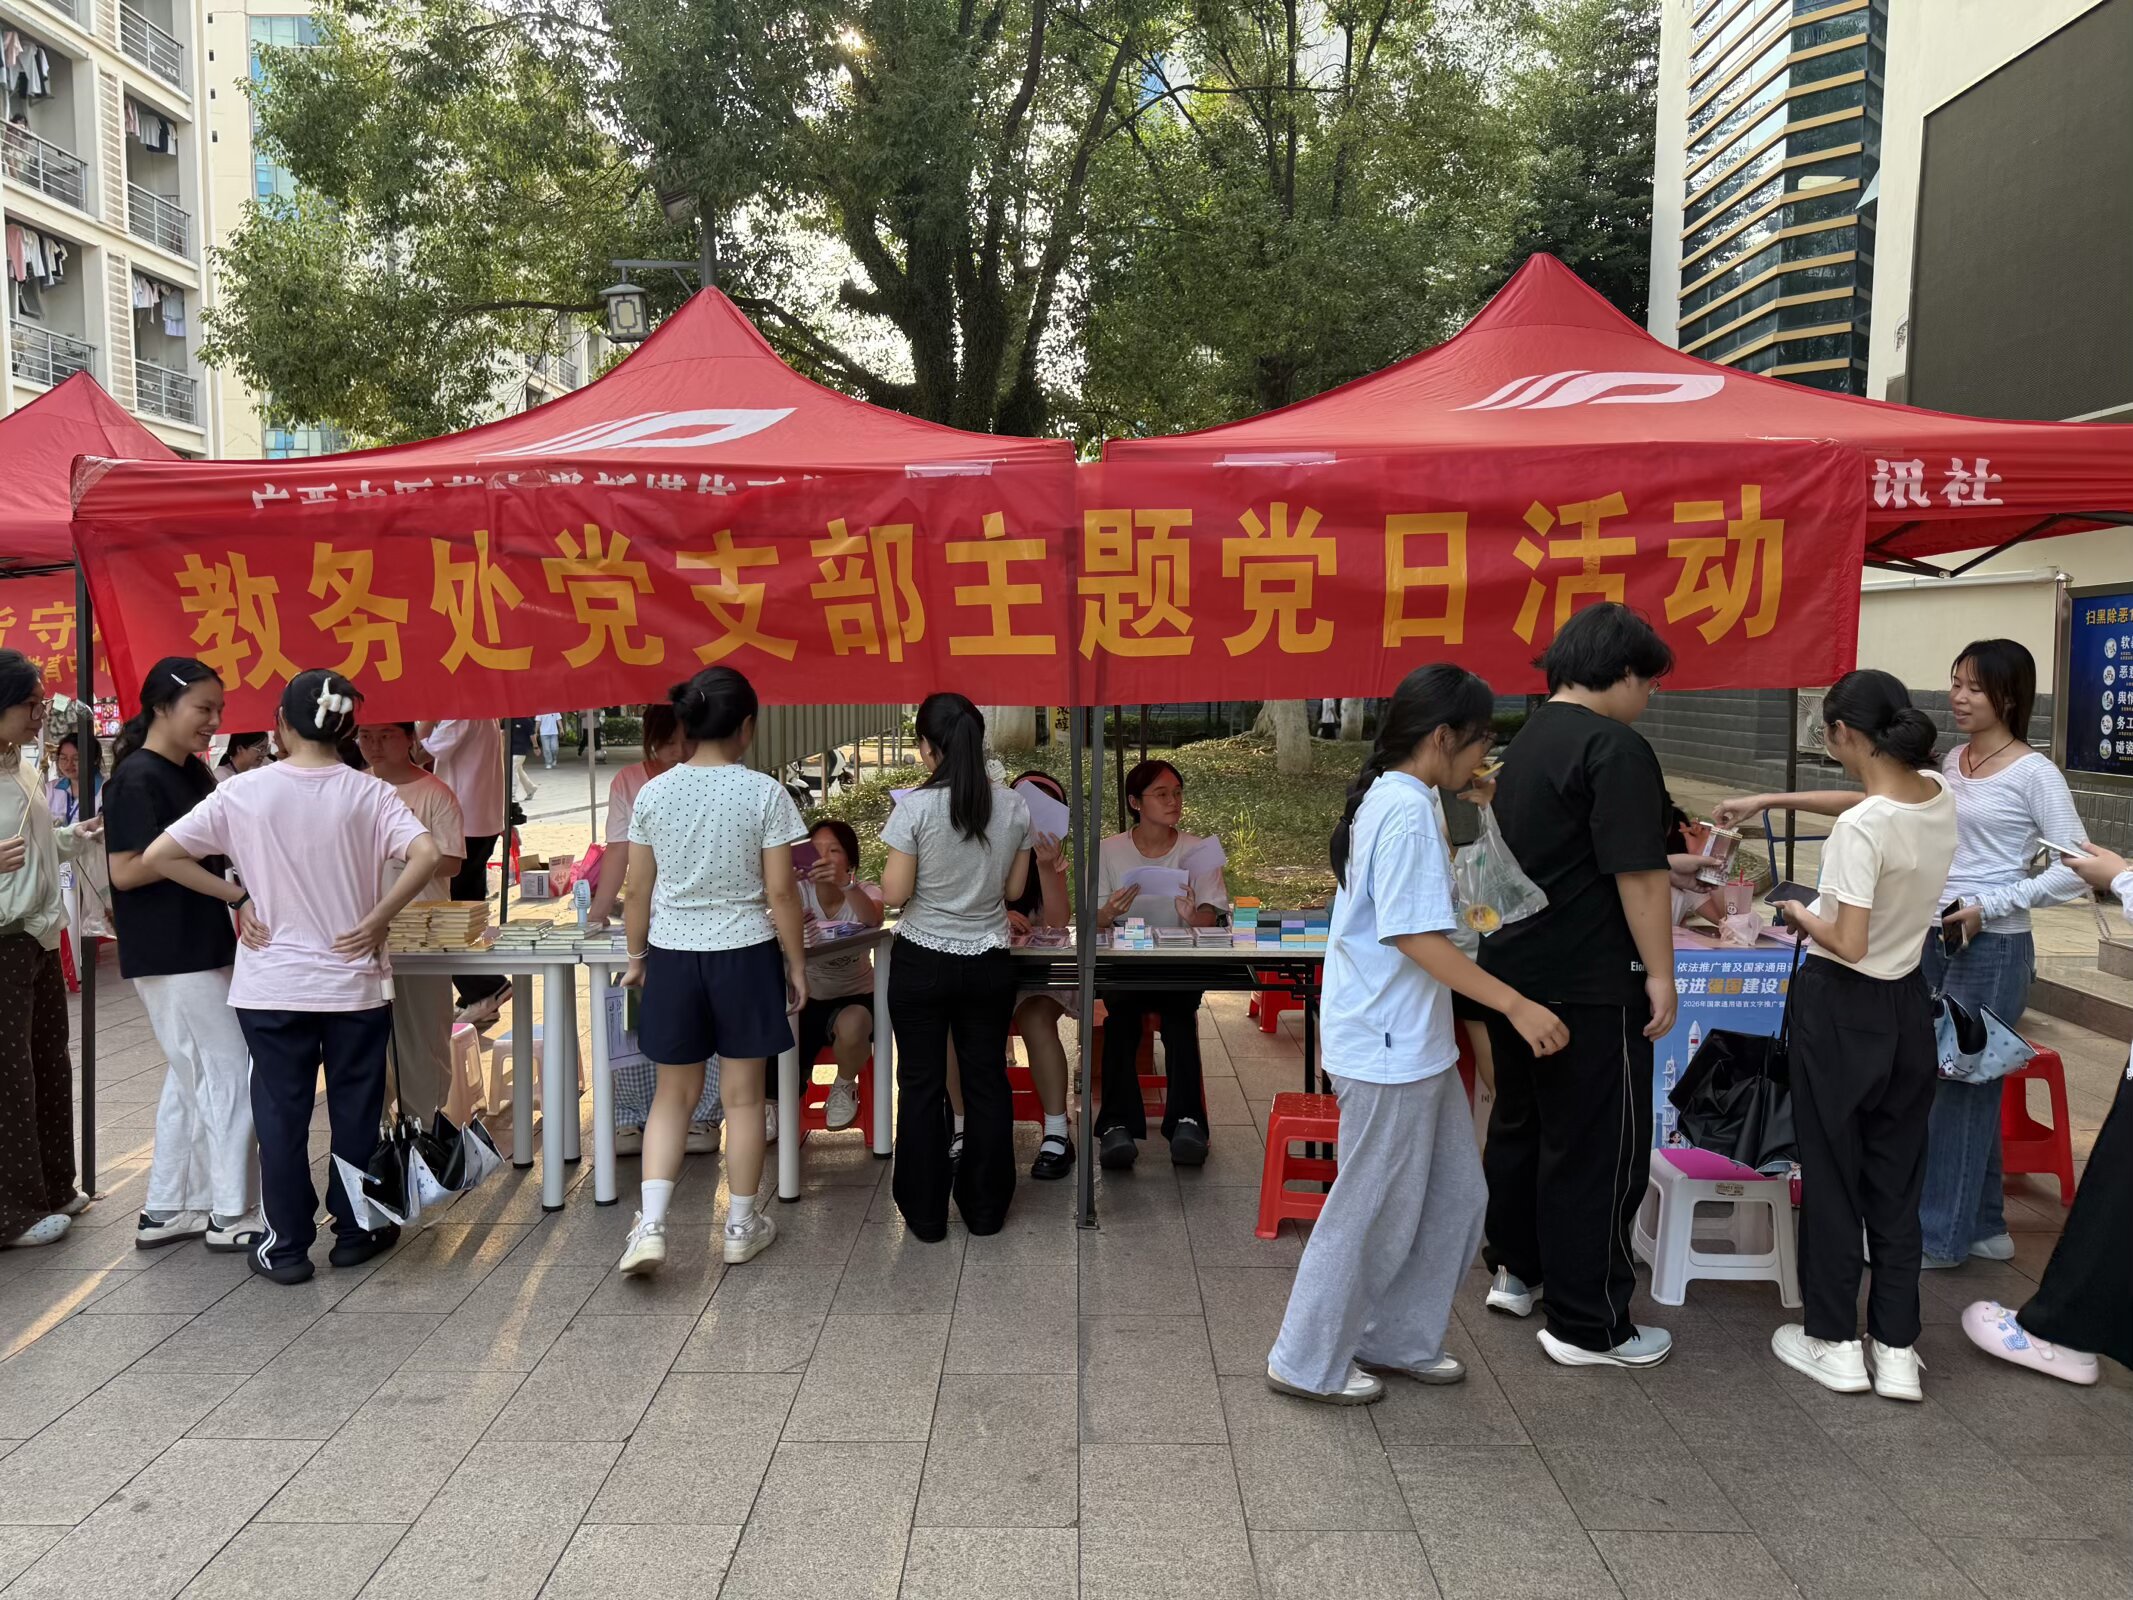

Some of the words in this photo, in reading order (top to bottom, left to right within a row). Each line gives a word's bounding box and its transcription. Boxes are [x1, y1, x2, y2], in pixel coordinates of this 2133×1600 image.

[1871, 457, 2004, 509] 讯社
[174, 485, 1785, 692] 教务处党支部主题党日活动
[2085, 606, 2133, 625] 扫黑除恶
